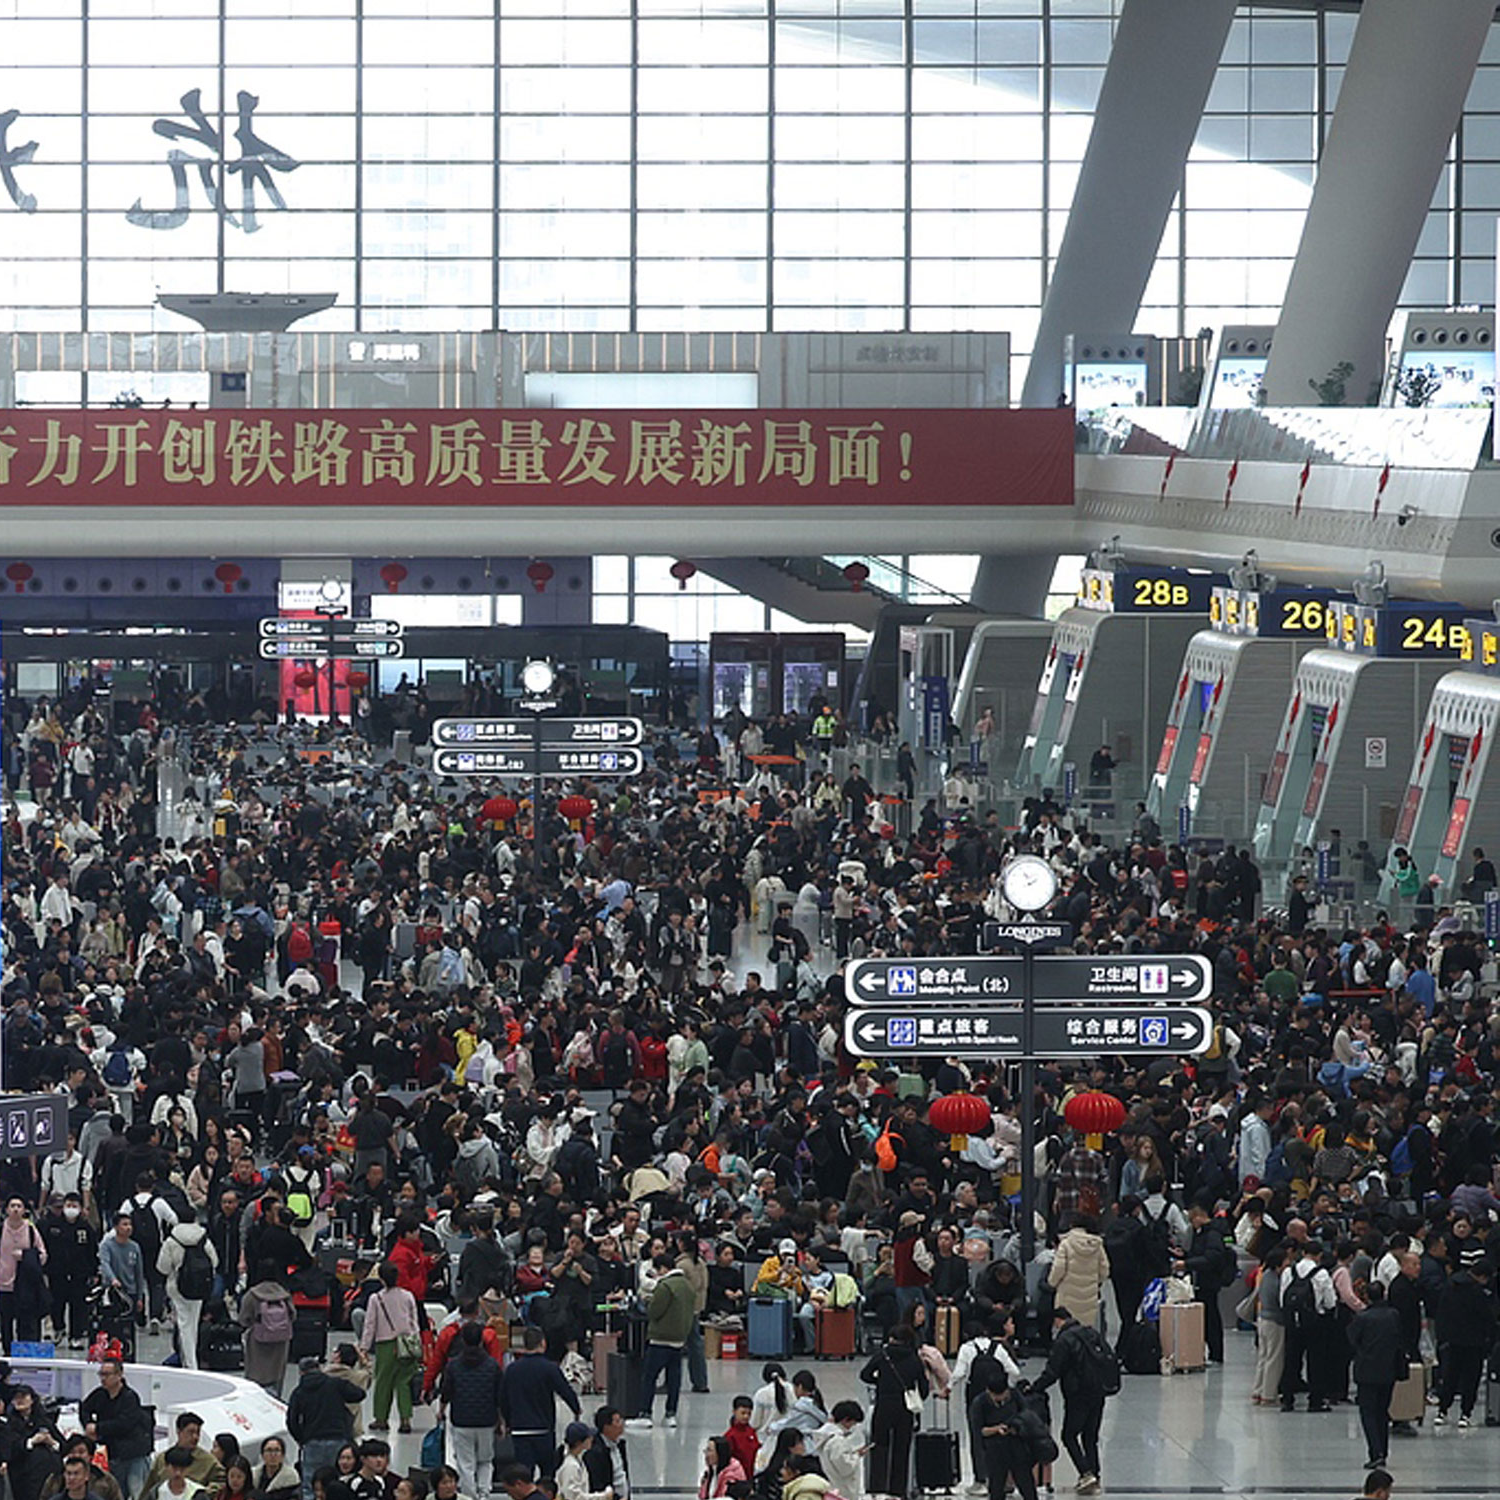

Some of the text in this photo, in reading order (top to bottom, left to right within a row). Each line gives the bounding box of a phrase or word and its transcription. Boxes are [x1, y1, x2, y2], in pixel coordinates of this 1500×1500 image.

[1134, 579, 1189, 605] 28B
[1282, 601, 1324, 630] 26
[1403, 617, 1466, 649] 24B
[997, 925, 1062, 937] LONGINES
[919, 967, 967, 984] 会合点
[1090, 966, 1138, 983] 卫生间
[1066, 1018, 1137, 1035] 综合服务
